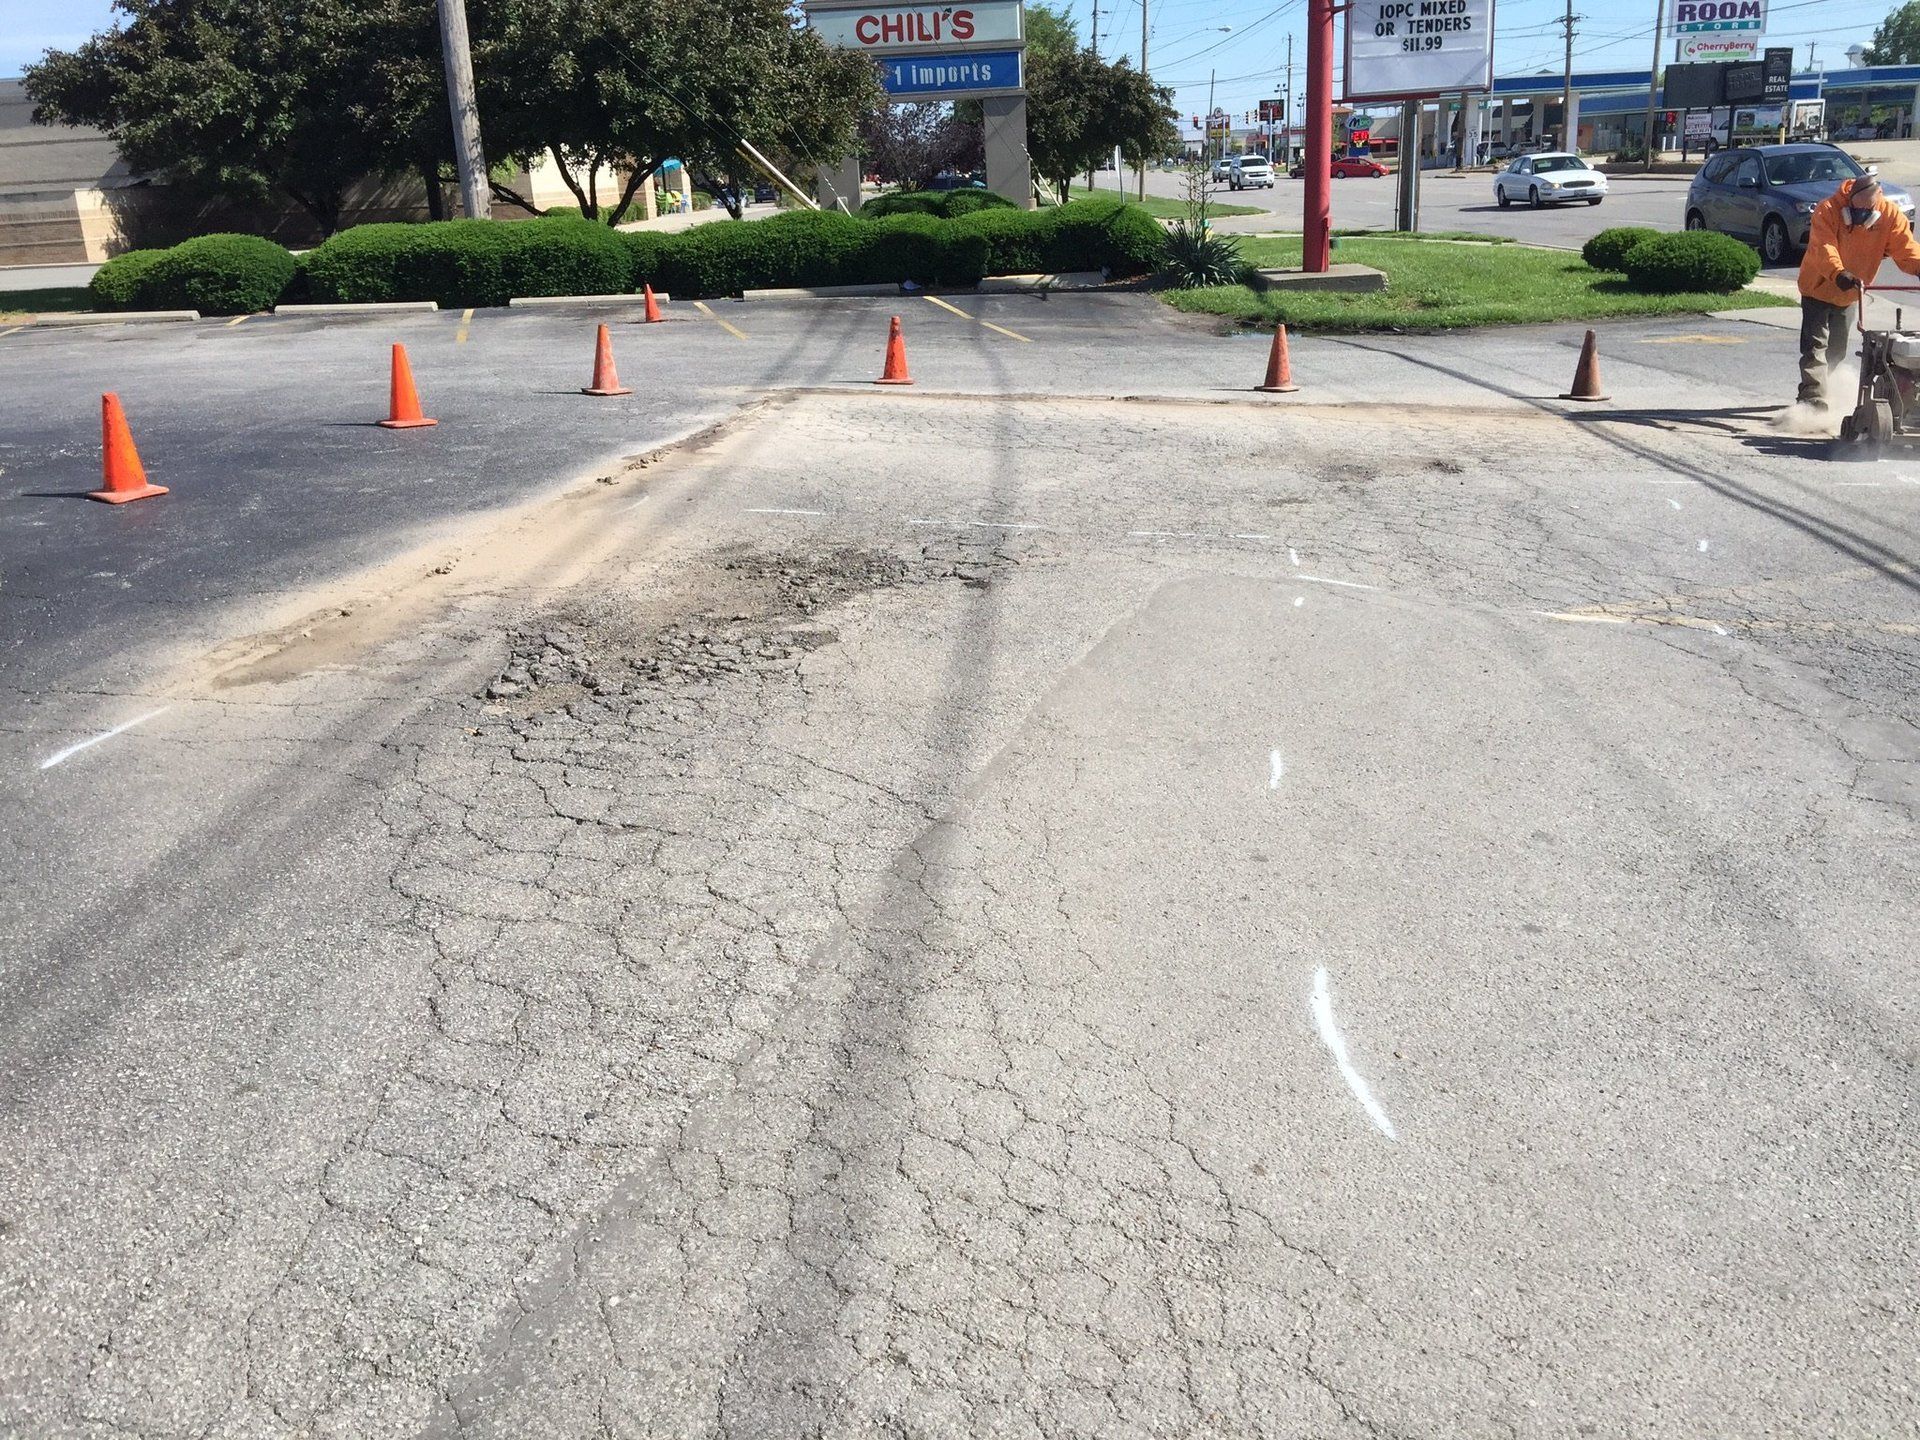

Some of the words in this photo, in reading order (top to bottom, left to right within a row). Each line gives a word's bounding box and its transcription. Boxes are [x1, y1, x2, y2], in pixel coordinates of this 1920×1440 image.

[1420, 0, 1466, 17] MIXED
[1677, 1, 1761, 22] ROOM
[856, 8, 974, 44] CHILI'S
[1375, 22, 1395, 37] OR
[1407, 16, 1472, 34] TENDERS
[1680, 21, 1756, 32] STORE
[1402, 36, 1443, 52] $11.99
[1697, 41, 1755, 52] CherryBerry
[912, 63, 991, 86] imports
[1768, 75, 1786, 83] REAL
